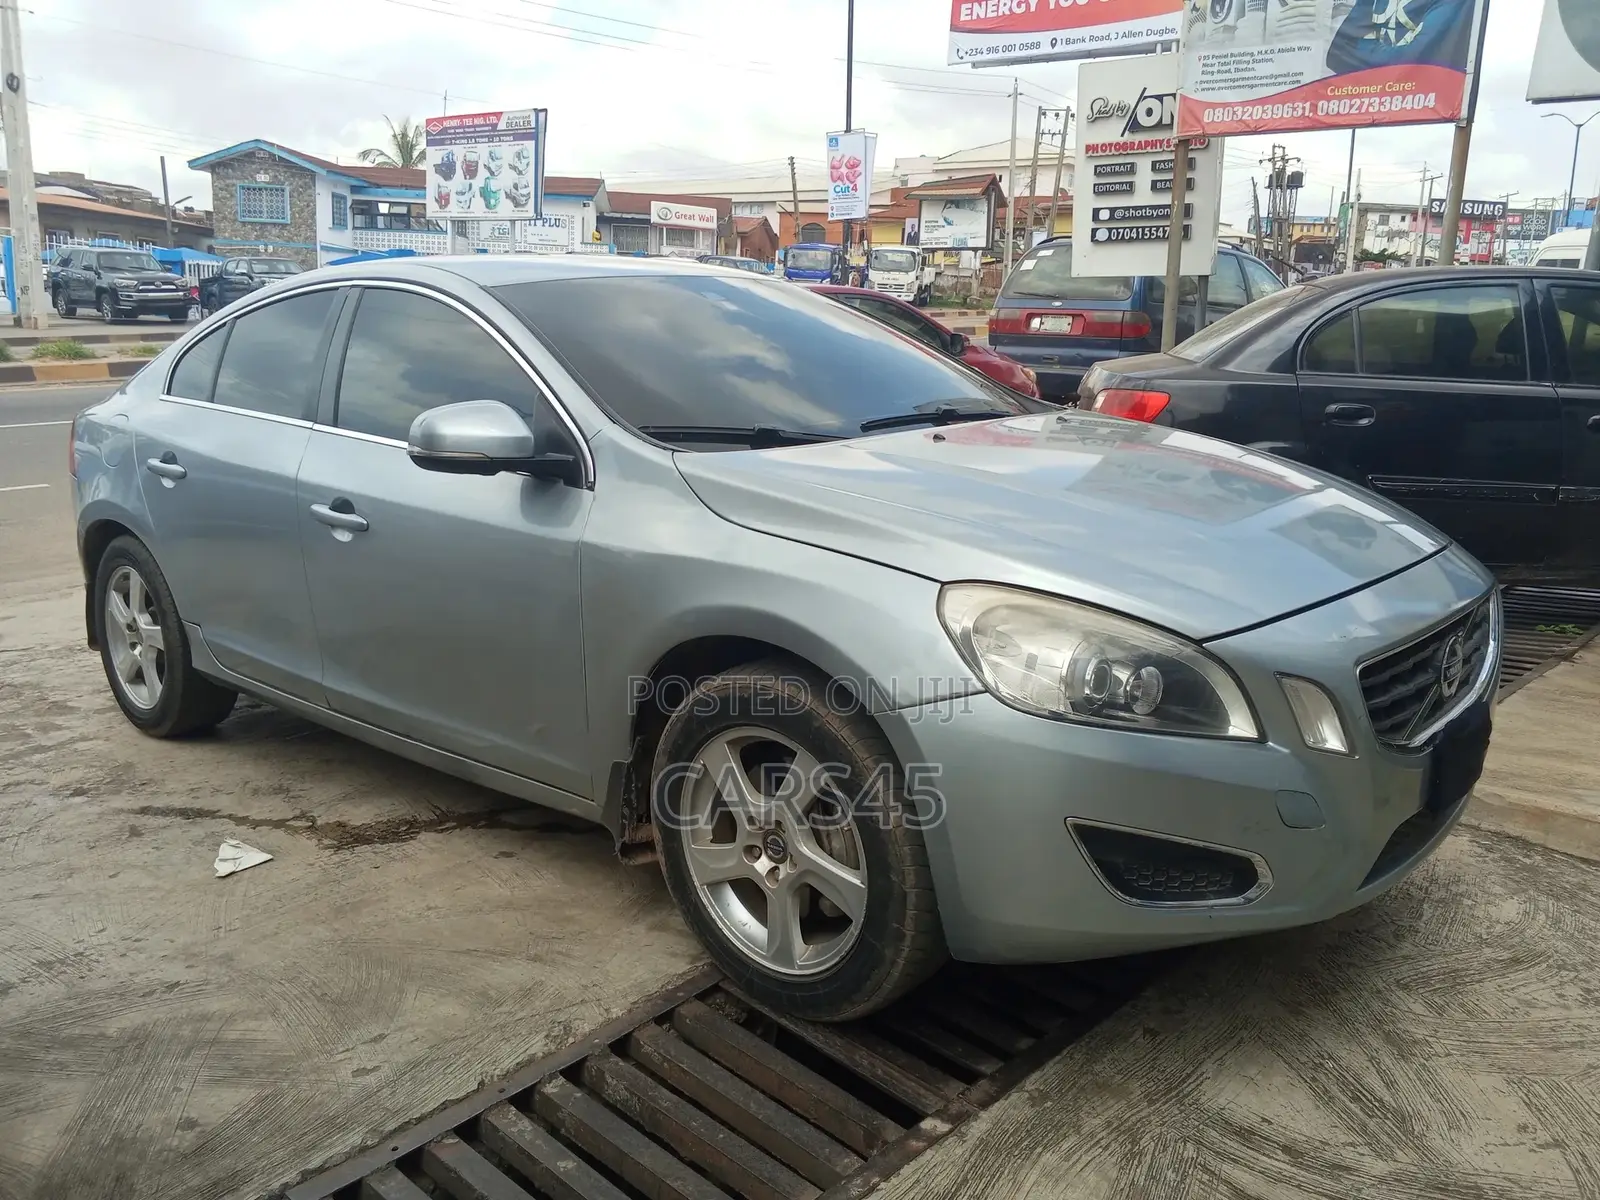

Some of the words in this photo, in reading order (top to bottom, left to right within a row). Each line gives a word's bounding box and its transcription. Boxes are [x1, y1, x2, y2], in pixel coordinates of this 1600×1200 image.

[960, 0, 1039, 21] ENERGY
[965, 48, 984, 57] +234
[986, 46, 1000, 55] 916
[1001, 43, 1016, 54] 001
[1018, 41, 1041, 51] 0588
[1065, 36, 1087, 46] Bank
[1089, 32, 1113, 42] Road,
[1120, 30, 1143, 39] Allen
[1146, 26, 1178, 37] Dugbe,
[1230, 50, 1256, 59] Building,
[1276, 47, 1296, 55] Abiola
[1217, 59, 1231, 68] Total
[1232, 58, 1250, 66] Filling
[1327, 85, 1383, 96] Customer
[1385, 81, 1416, 92] Care:
[1203, 101, 1313, 123] 08032039631,
[1317, 93, 1436, 116] 08027338404
[505, 119, 532, 129] DEALER
[1085, 139, 1164, 155] PHOTOGRAPHY
[1096, 161, 1132, 173] PORTRAIT
[1156, 161, 1174, 170] FASH
[833, 184, 850, 194] Cut
[851, 183, 858, 193] 4
[1094, 183, 1131, 193] EDITORIAL
[1431, 200, 1503, 216] SASUNG
[542, 217, 567, 229] PLUS
[674, 211, 695, 222] Great
[698, 213, 714, 224] Wall
